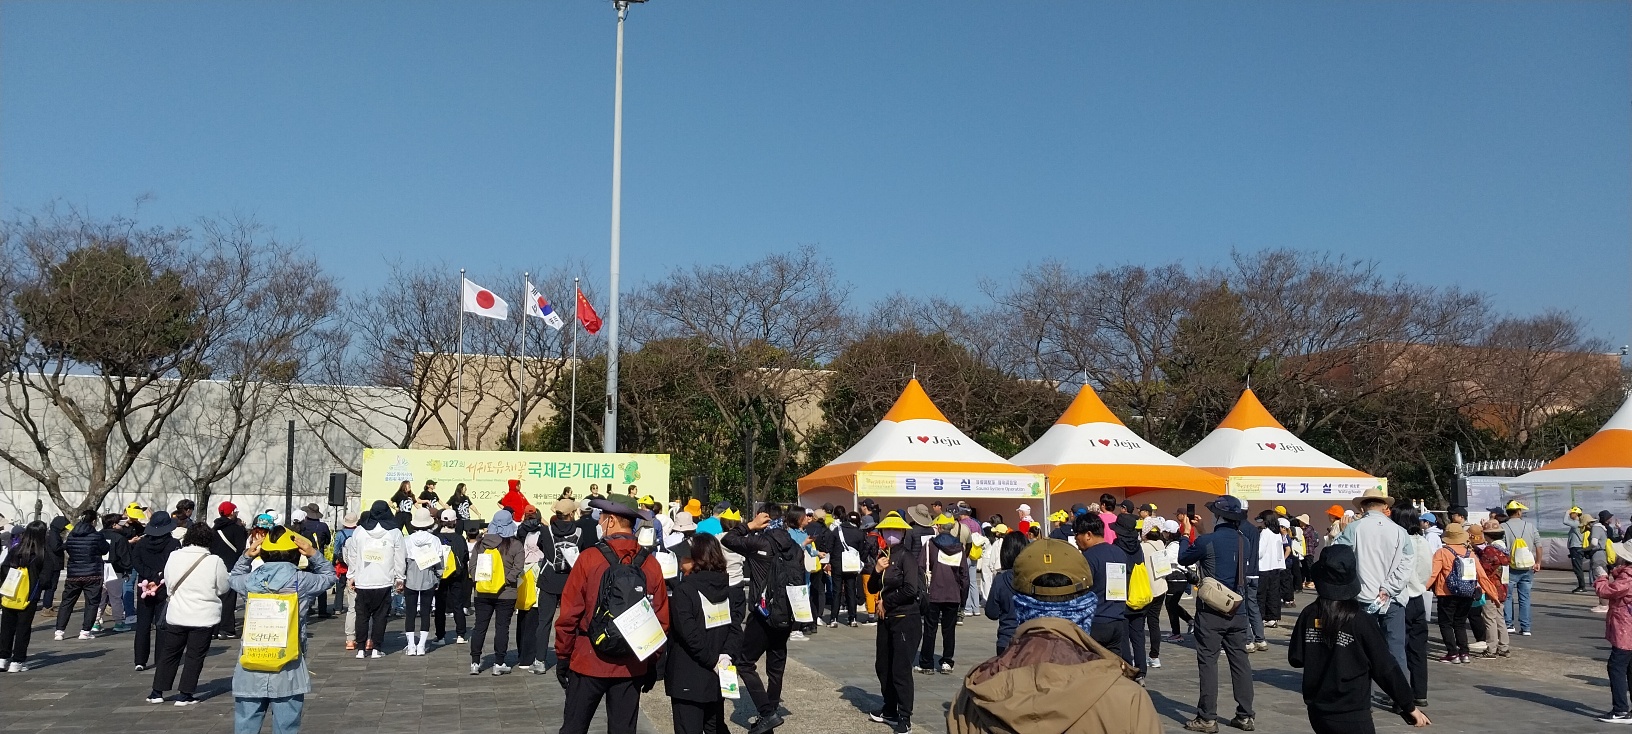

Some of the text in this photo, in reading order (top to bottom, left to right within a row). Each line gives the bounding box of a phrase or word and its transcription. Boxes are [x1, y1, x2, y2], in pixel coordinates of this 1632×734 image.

[906, 435, 961, 447] I Jeju
[1089, 439, 1141, 450] I Jeju
[1256, 442, 1305, 453] I Jeju
[443, 460, 466, 468] 제27회
[527, 461, 615, 479] 국제걷기대회
